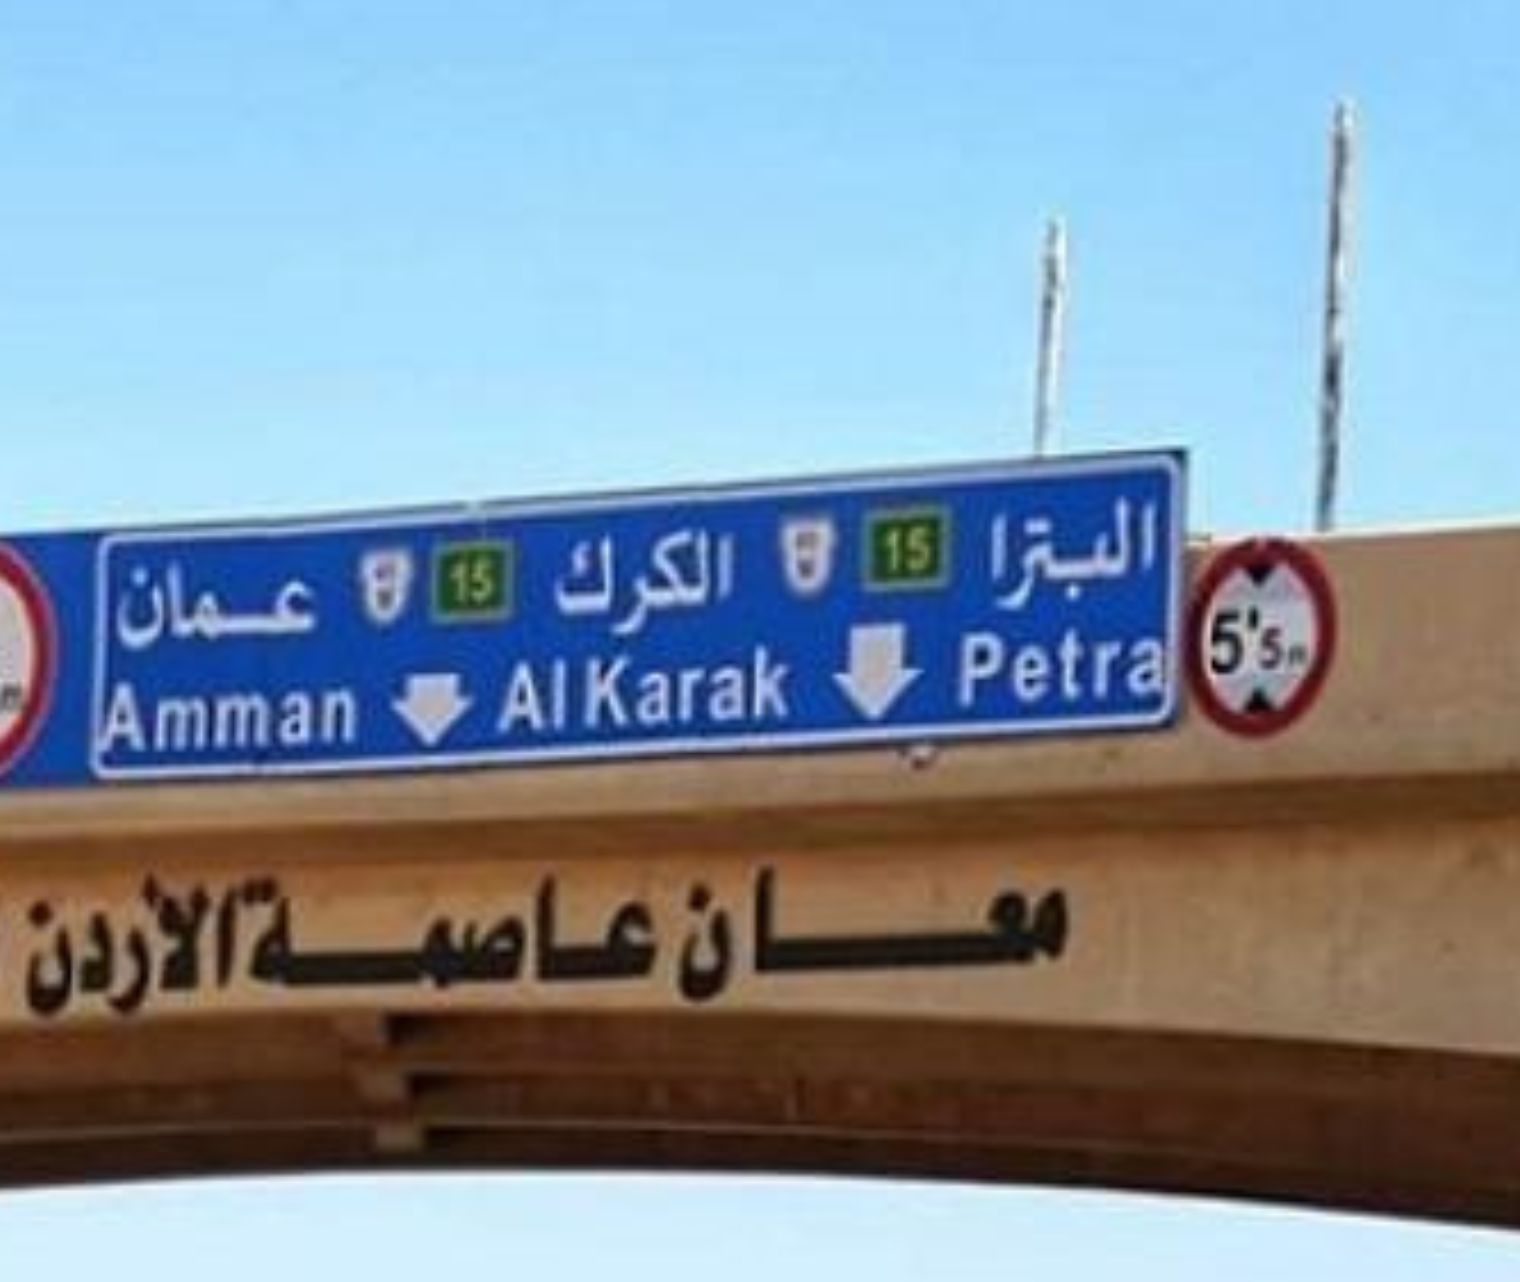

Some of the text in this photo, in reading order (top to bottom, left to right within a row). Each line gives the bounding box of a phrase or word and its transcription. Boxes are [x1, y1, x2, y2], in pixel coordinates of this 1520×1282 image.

[448, 556, 496, 606] 15
[555, 524, 732, 635] الكرك
[886, 526, 931, 573] 15
[991, 496, 1157, 611] البترا
[115, 559, 317, 652] عمان
[960, 632, 1168, 708] Petra
[92, 682, 357, 756] Amman
[678, 865, 1070, 1003] معان
